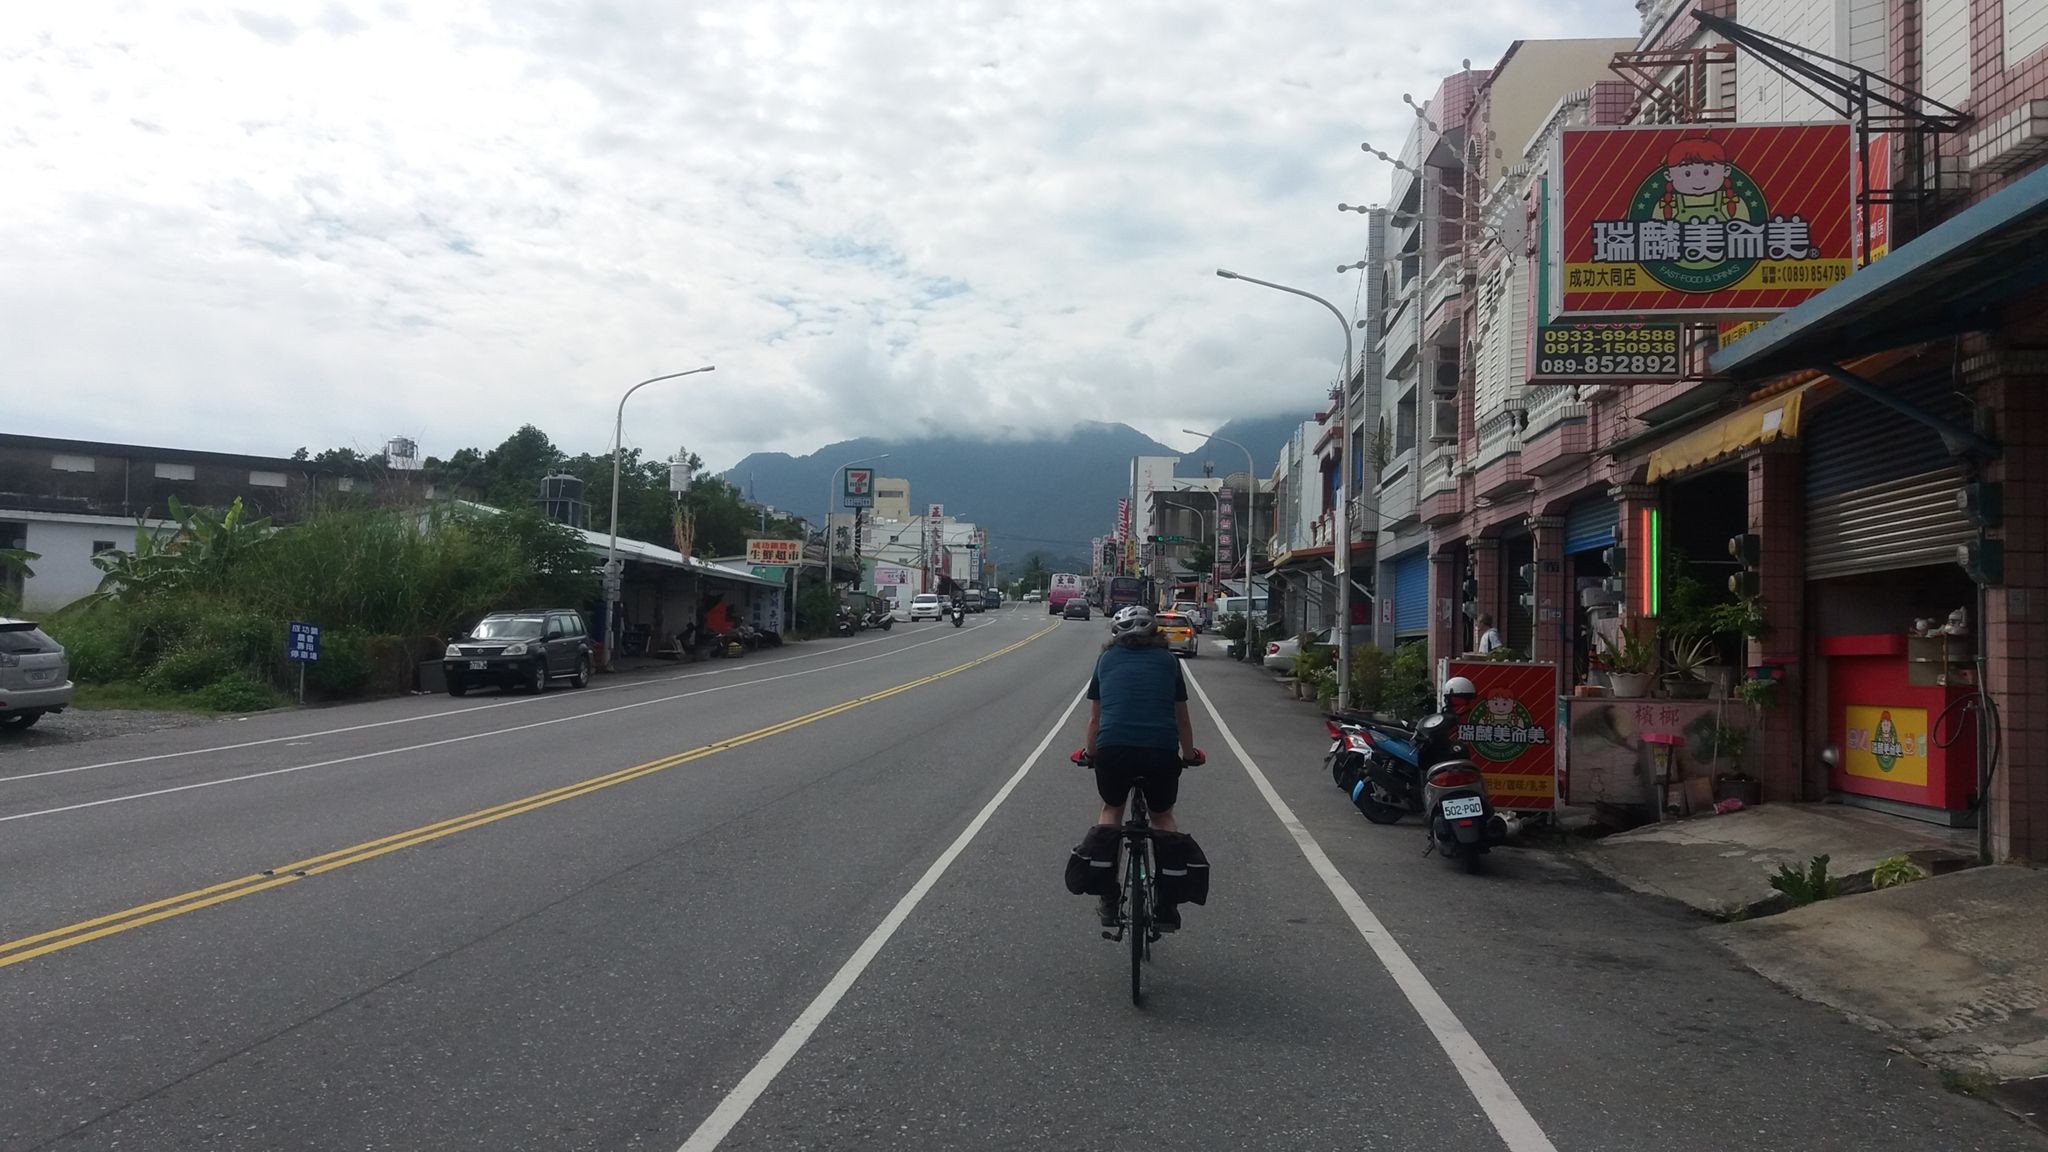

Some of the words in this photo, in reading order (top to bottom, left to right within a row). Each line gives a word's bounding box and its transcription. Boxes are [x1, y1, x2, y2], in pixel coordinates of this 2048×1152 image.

[1593, 216, 1810, 262] 瑞麟美而美
[1568, 268, 1637, 288] 成功大同店
[1712, 264, 1740, 283] DRINKS
[1544, 330, 1677, 342] 0933-694588
[1544, 342, 1677, 354] 0912-150936
[1541, 355, 1677, 373] 089-852892
[1457, 725, 1545, 743] 瑞麟美而美
